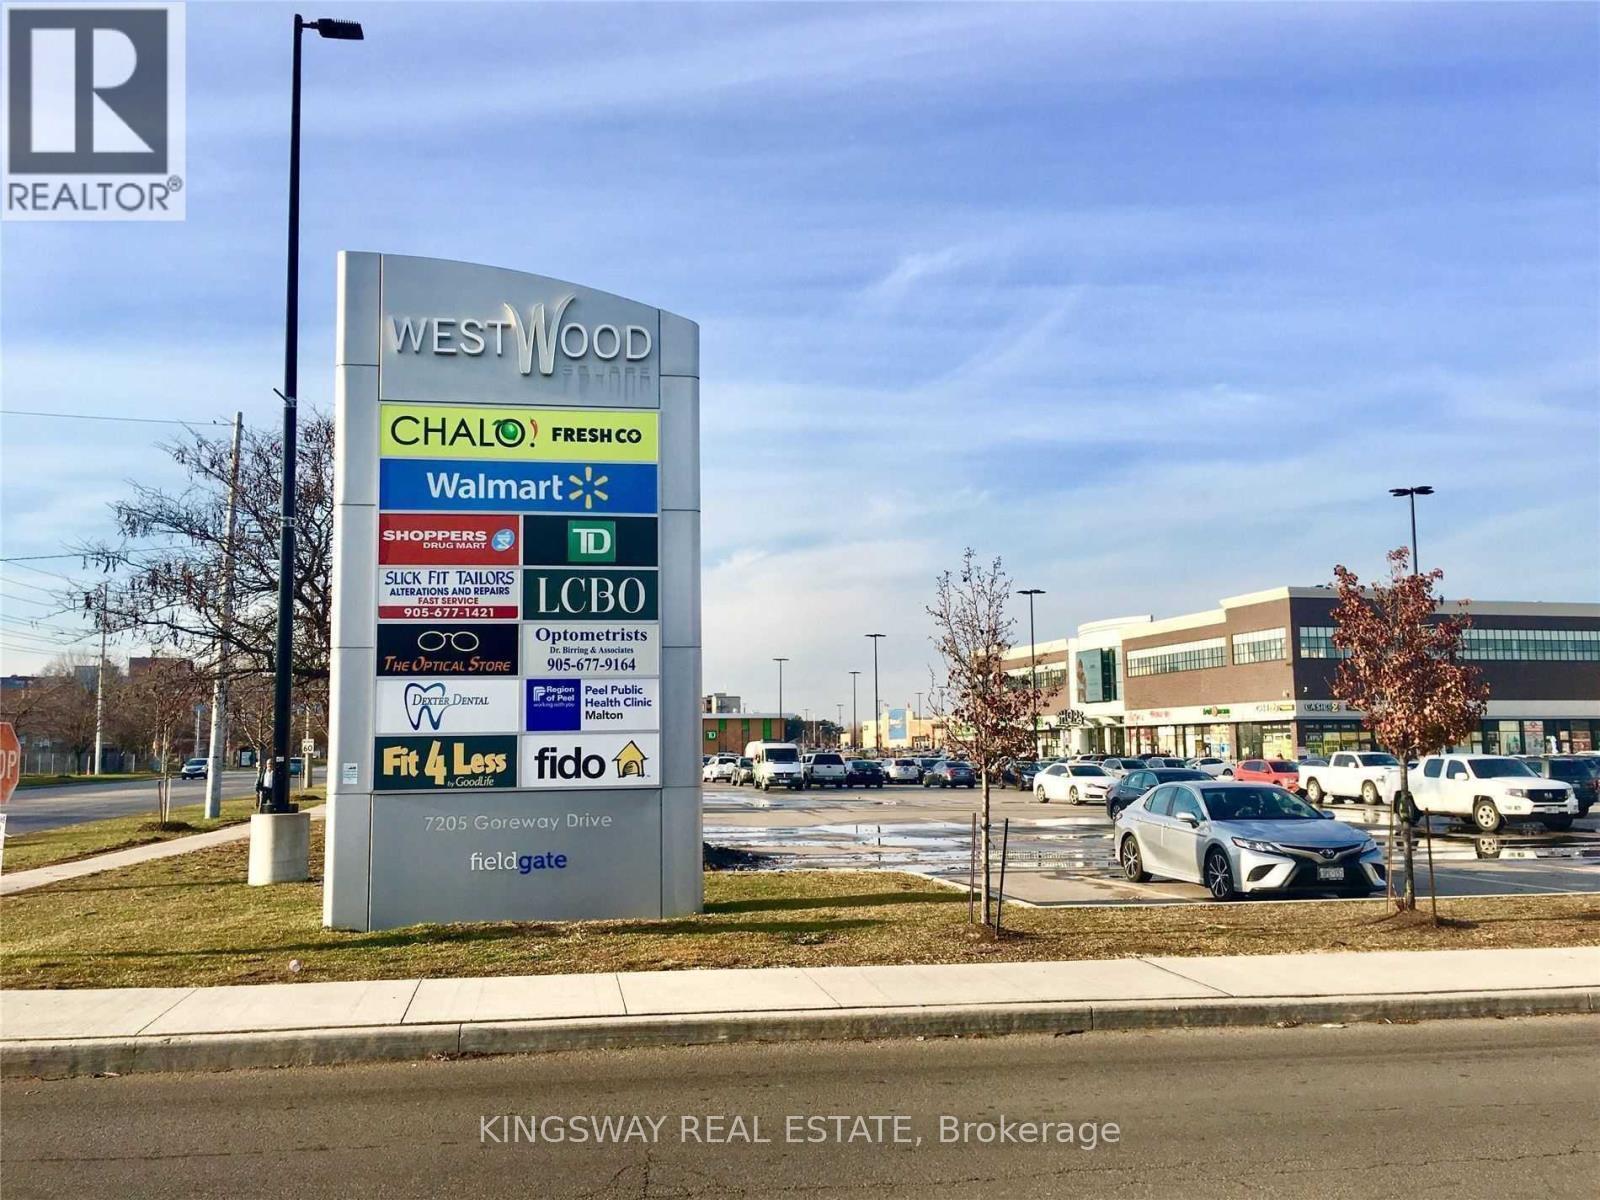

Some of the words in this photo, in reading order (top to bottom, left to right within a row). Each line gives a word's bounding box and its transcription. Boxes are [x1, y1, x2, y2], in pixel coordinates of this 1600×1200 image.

[388, 294, 652, 376] WESTWOOD
[426, 472, 563, 500] Walmart
[382, 530, 487, 541] SHOPPERS
[572, 528, 612, 555] TD
[384, 570, 422, 585] SLICK
[428, 571, 449, 585] FIT
[456, 571, 515, 585] TAILORS
[389, 587, 449, 596] ALTERATIONS
[451, 587, 472, 596] AND
[473, 586, 510, 596] REPAIRS
[537, 576, 646, 614] LCBO
[418, 597, 440, 605] FAST
[441, 597, 479, 605] SERVICE
[403, 607, 495, 618] 905-677-1421
[535, 627, 648, 645] Optometrists
[562, 646, 589, 655] Birring
[590, 646, 597, 654] &
[598, 646, 634, 654] Associates
[547, 657, 636, 672] 905-677-9164
[546, 685, 575, 694] Region
[585, 685, 608, 695] Peel
[610, 685, 643, 695] Public
[546, 694, 556, 702] of
[585, 697, 621, 708] Health
[623, 697, 653, 708] Clinic
[585, 710, 624, 720] Malton
[303, 744, 313, 752] 60
[383, 745, 420, 778] Fit
[424, 739, 448, 786] 4
[453, 742, 508, 775] Less
[534, 747, 606, 780] fido
[424, 816, 468, 831] 7205
[474, 814, 560, 831] Goreway
[566, 812, 613, 828] Drive
[470, 851, 568, 875] fieldgate
